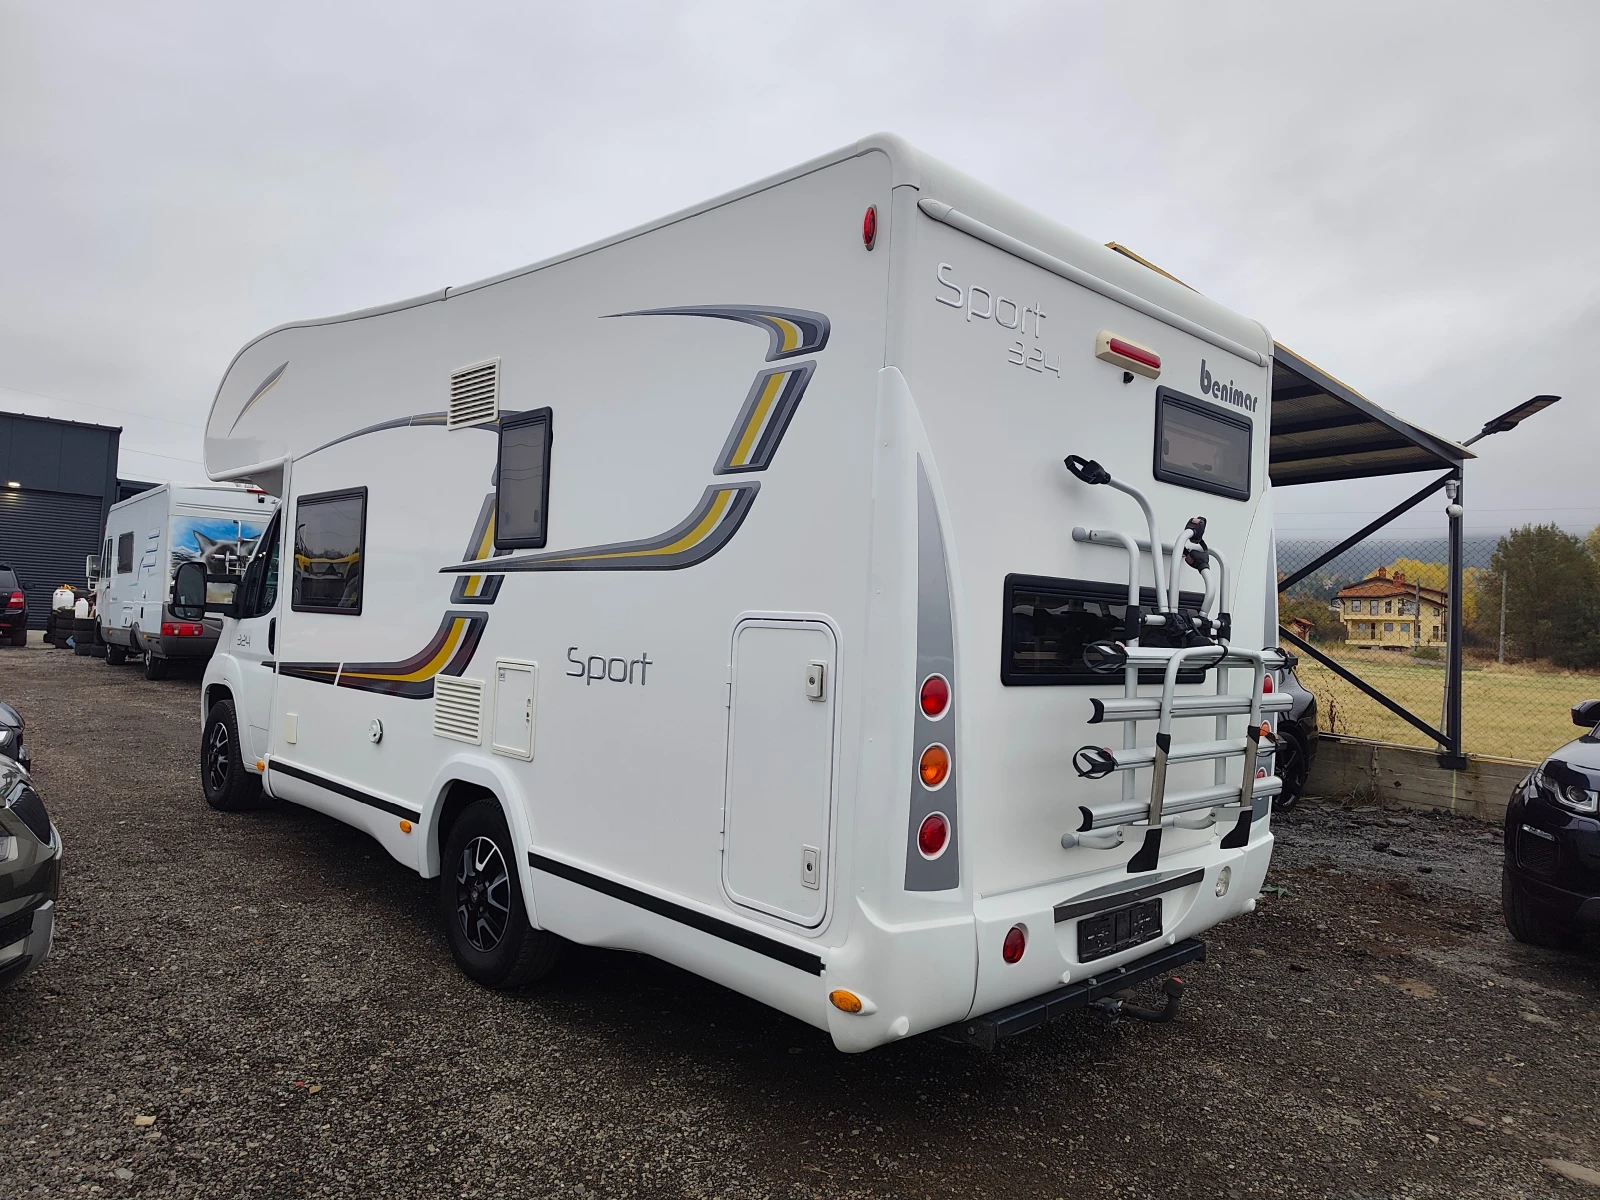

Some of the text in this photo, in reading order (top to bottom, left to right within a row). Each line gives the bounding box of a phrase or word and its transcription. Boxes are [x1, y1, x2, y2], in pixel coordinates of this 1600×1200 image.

[935, 262, 1046, 339] Sport
[1008, 340, 1061, 379] 324
[1199, 358, 1258, 413] benimar
[236, 634, 251, 648] 324
[566, 645, 654, 686] Sport
